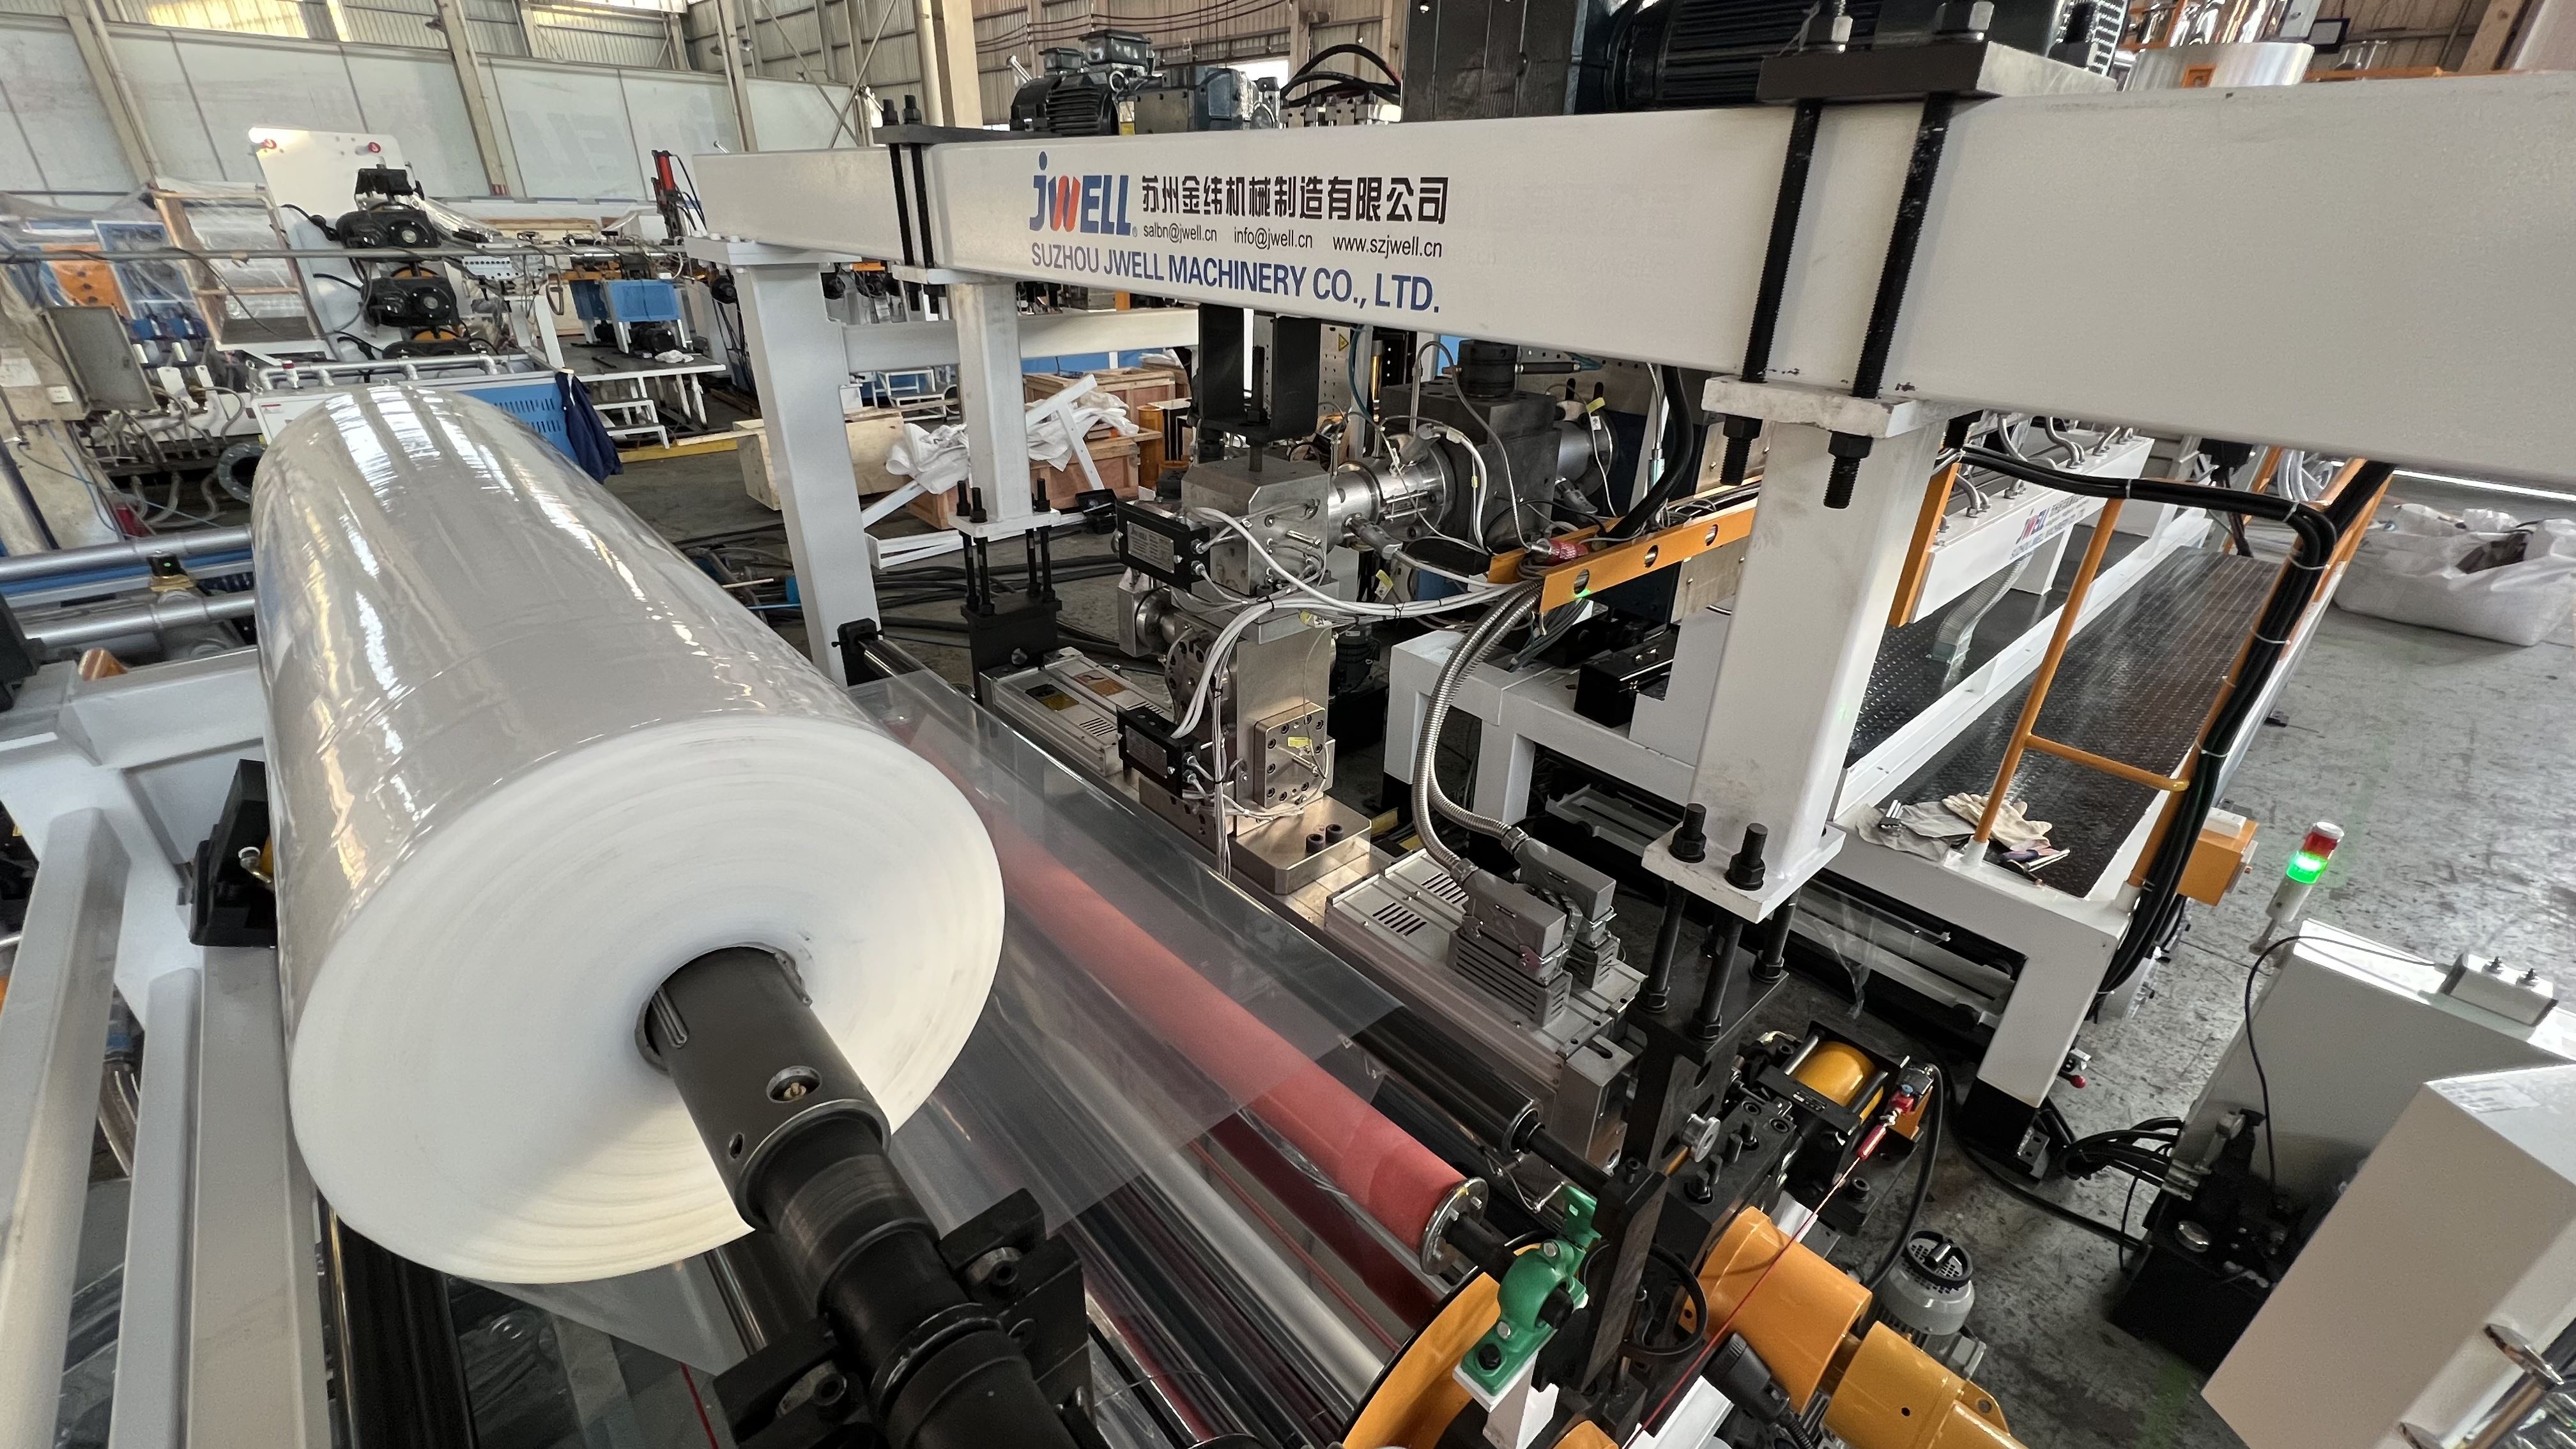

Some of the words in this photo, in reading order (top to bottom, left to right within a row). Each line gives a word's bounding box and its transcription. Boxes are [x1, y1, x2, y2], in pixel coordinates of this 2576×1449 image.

[1142, 174, 1449, 225] 苏州金纬机械制造有限公司
[1144, 222, 1217, 245] salbn@jwell.cn
[1234, 226, 1313, 250] info@jwell.cn
[1333, 234, 1443, 259] www.szjwell.cn
[1032, 242, 1100, 274] SUZHOU
[1103, 249, 1165, 284] JWELL
[1169, 254, 1307, 298] MACHINERY
[1313, 267, 1367, 309] CO.,
[1375, 273, 1440, 313] LTD.
